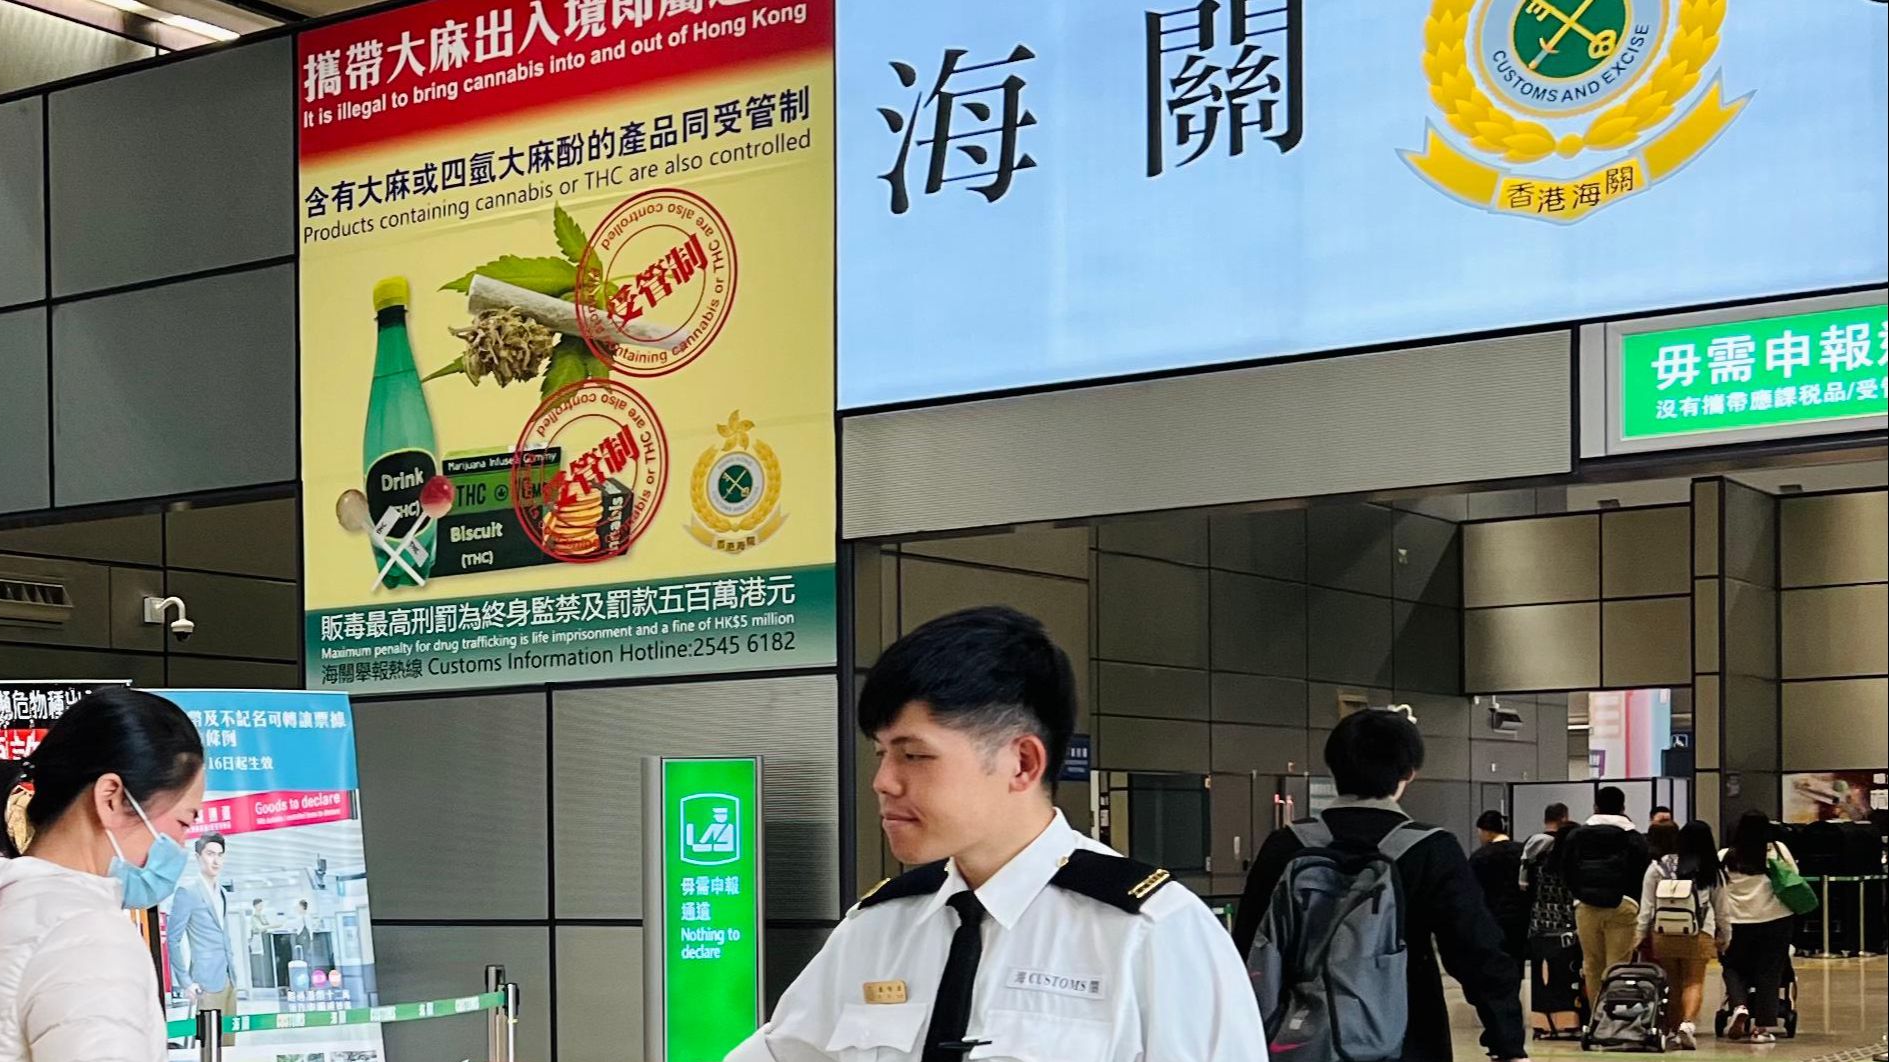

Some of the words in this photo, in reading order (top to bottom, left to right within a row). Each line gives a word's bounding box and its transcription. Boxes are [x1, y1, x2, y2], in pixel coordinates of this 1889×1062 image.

[303, 0, 753, 103] 攜帶大麻出入境即
[1492, 49, 1558, 103] CUSTOMS
[1561, 79, 1601, 103] AND
[1601, 23, 1651, 85] EXCISE
[303, 109, 314, 128] It
[318, 106, 333, 125] is
[337, 93, 386, 120] illegal
[391, 90, 409, 109] to
[413, 81, 458, 104] bring
[463, 60, 544, 92] cannabis
[550, 50, 585, 73] into
[590, 39, 625, 65] and
[630, 32, 662, 55] out
[668, 22, 688, 47] of
[693, 16, 746, 42] Hong
[752, 3, 807, 29] Kong
[303, 217, 374, 244] Products
[379, 197, 470, 231] containing
[475, 180, 554, 211] cannabis
[559, 176, 579, 196] or
[584, 166, 624, 191] THC
[629, 162, 659, 182] are
[664, 153, 703, 175] also
[709, 128, 811, 166] controlled
[1507, 166, 1634, 213] 香港海關
[667, 202, 695, 220] also
[708, 239, 724, 274] THC
[607, 233, 709, 333] 受管制
[714, 276, 724, 294] or
[605, 338, 667, 364] ntaining
[1651, 321, 1889, 391] 毋需申報
[381, 467, 424, 492] Drink
[457, 483, 486, 507] THC
[321, 647, 372, 660] Maximum
[374, 641, 412, 659] penalty
[415, 640, 431, 653] for
[434, 638, 459, 654] drug
[462, 633, 517, 652] trafficking
[520, 633, 529, 645] is
[532, 630, 549, 643] life
[552, 626, 632, 644] imprisonment
[636, 623, 658, 637] and
[672, 619, 695, 632] fine
[698, 617, 712, 631] of
[714, 614, 748, 630] HK$5
[751, 612, 795, 627] million
[428, 655, 502, 676] Customs
[508, 646, 613, 671] Information
[747, 631, 796, 654] 6182
[255, 799, 288, 816] Goods
[680, 876, 740, 896] 毋需申報
[681, 901, 711, 922] 通道
[681, 928, 725, 945] Nothing
[727, 928, 740, 942] to
[681, 945, 721, 960] declare
[1028, 972, 1087, 992] CUSTOMS
